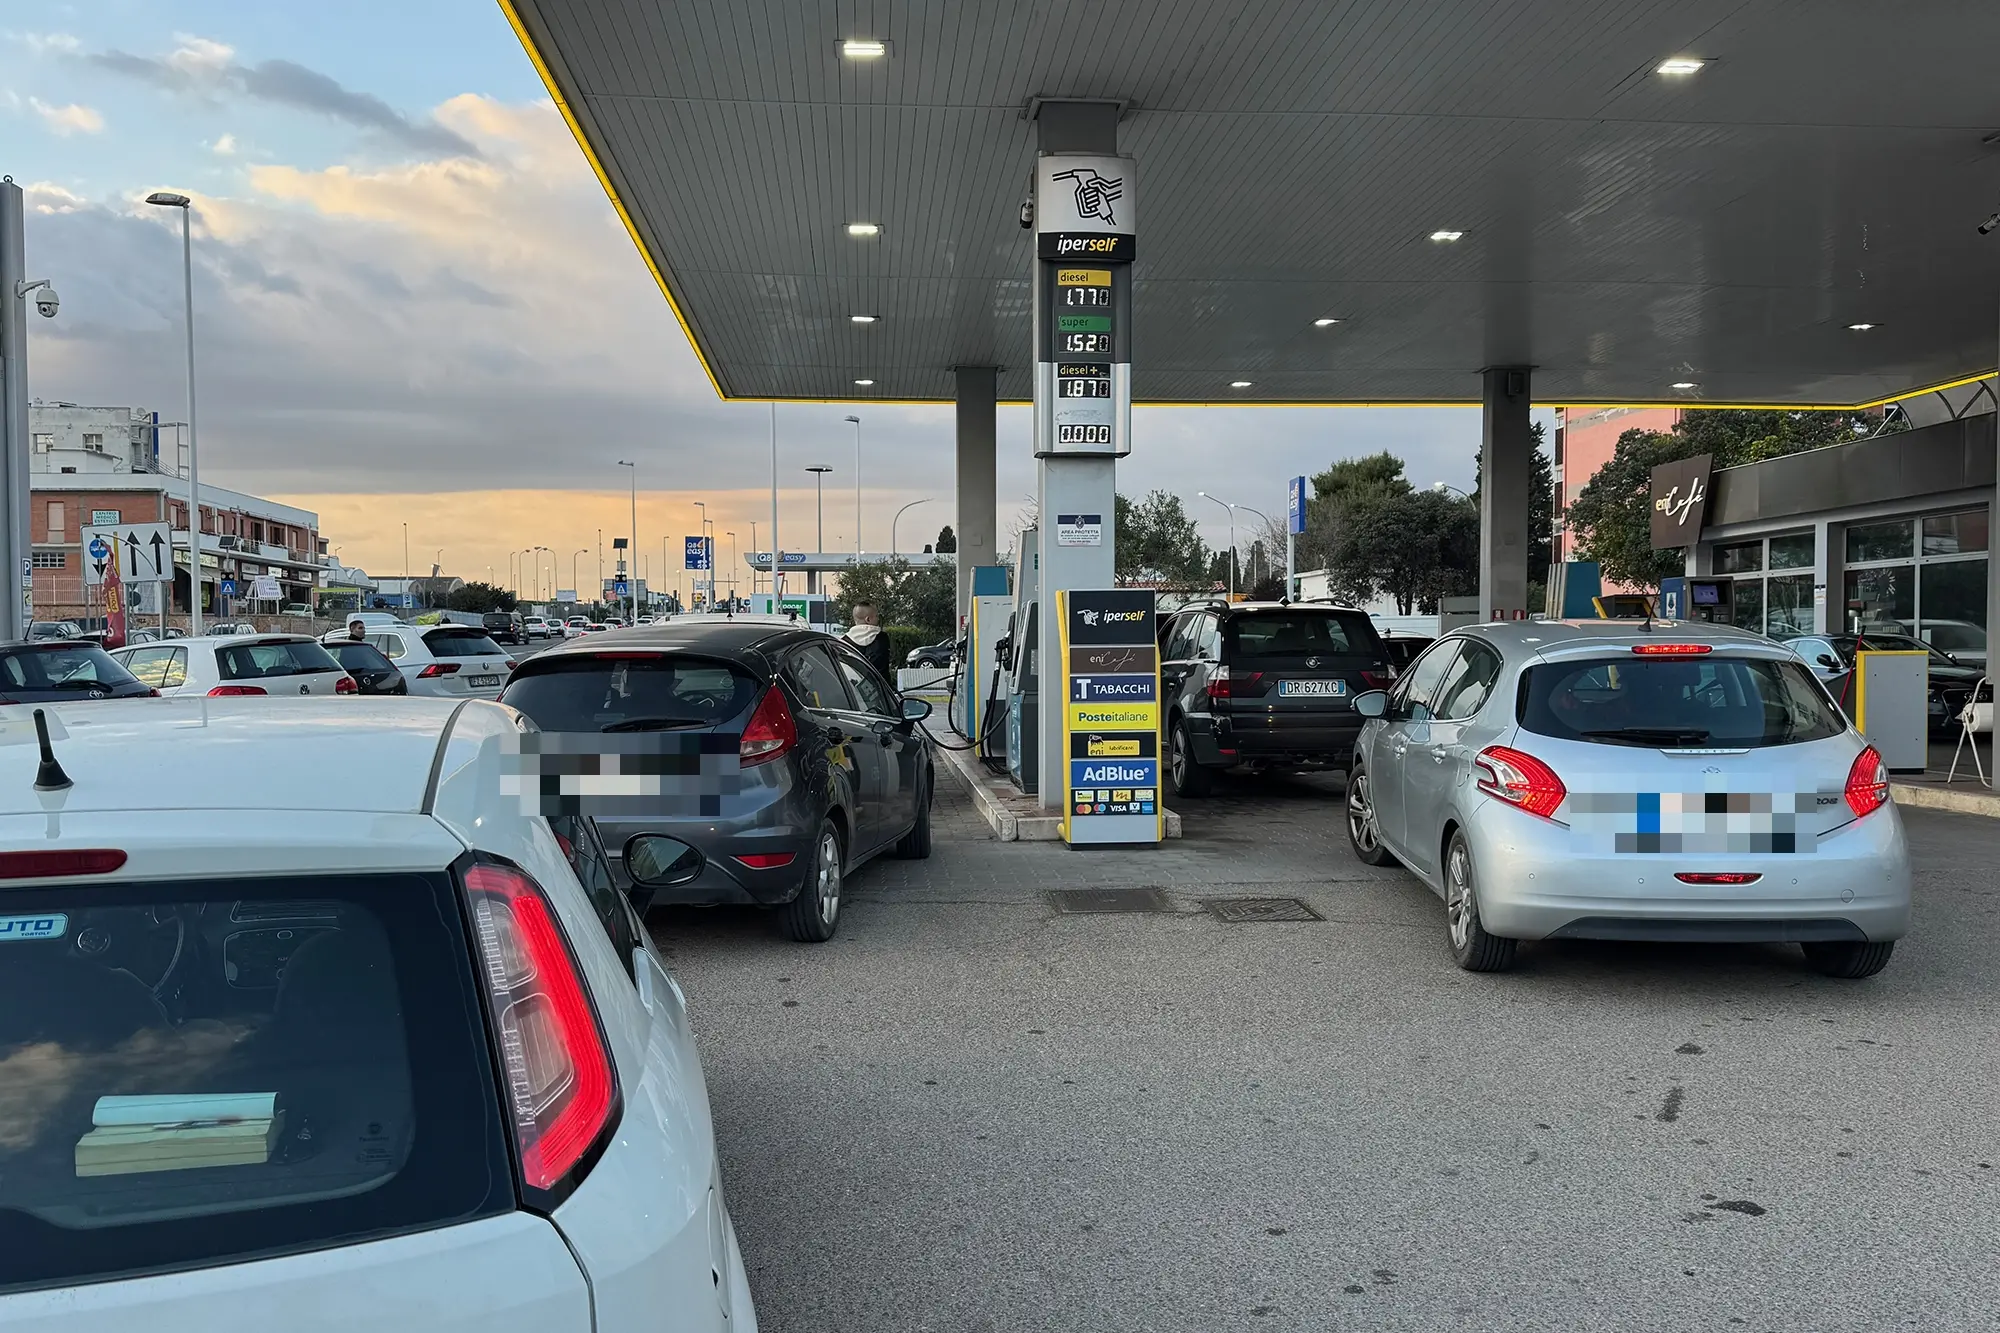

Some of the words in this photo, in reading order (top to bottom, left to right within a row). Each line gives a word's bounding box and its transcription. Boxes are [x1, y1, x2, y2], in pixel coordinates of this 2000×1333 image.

[1057, 234, 1119, 255] iperself
[1060, 272, 1089, 282] diesel
[1061, 319, 1089, 328] super
[759, 554, 772, 562] Q8
[784, 555, 804, 563] easy
[1103, 609, 1146, 624] iperself
[1093, 684, 1150, 694] TABACCHI
[1287, 682, 1300, 693] DR
[1304, 682, 1338, 693] 627KC
[1078, 712, 1149, 722] Posteitaliane
[1090, 747, 1104, 755] eni
[1110, 804, 1127, 812] VISA
